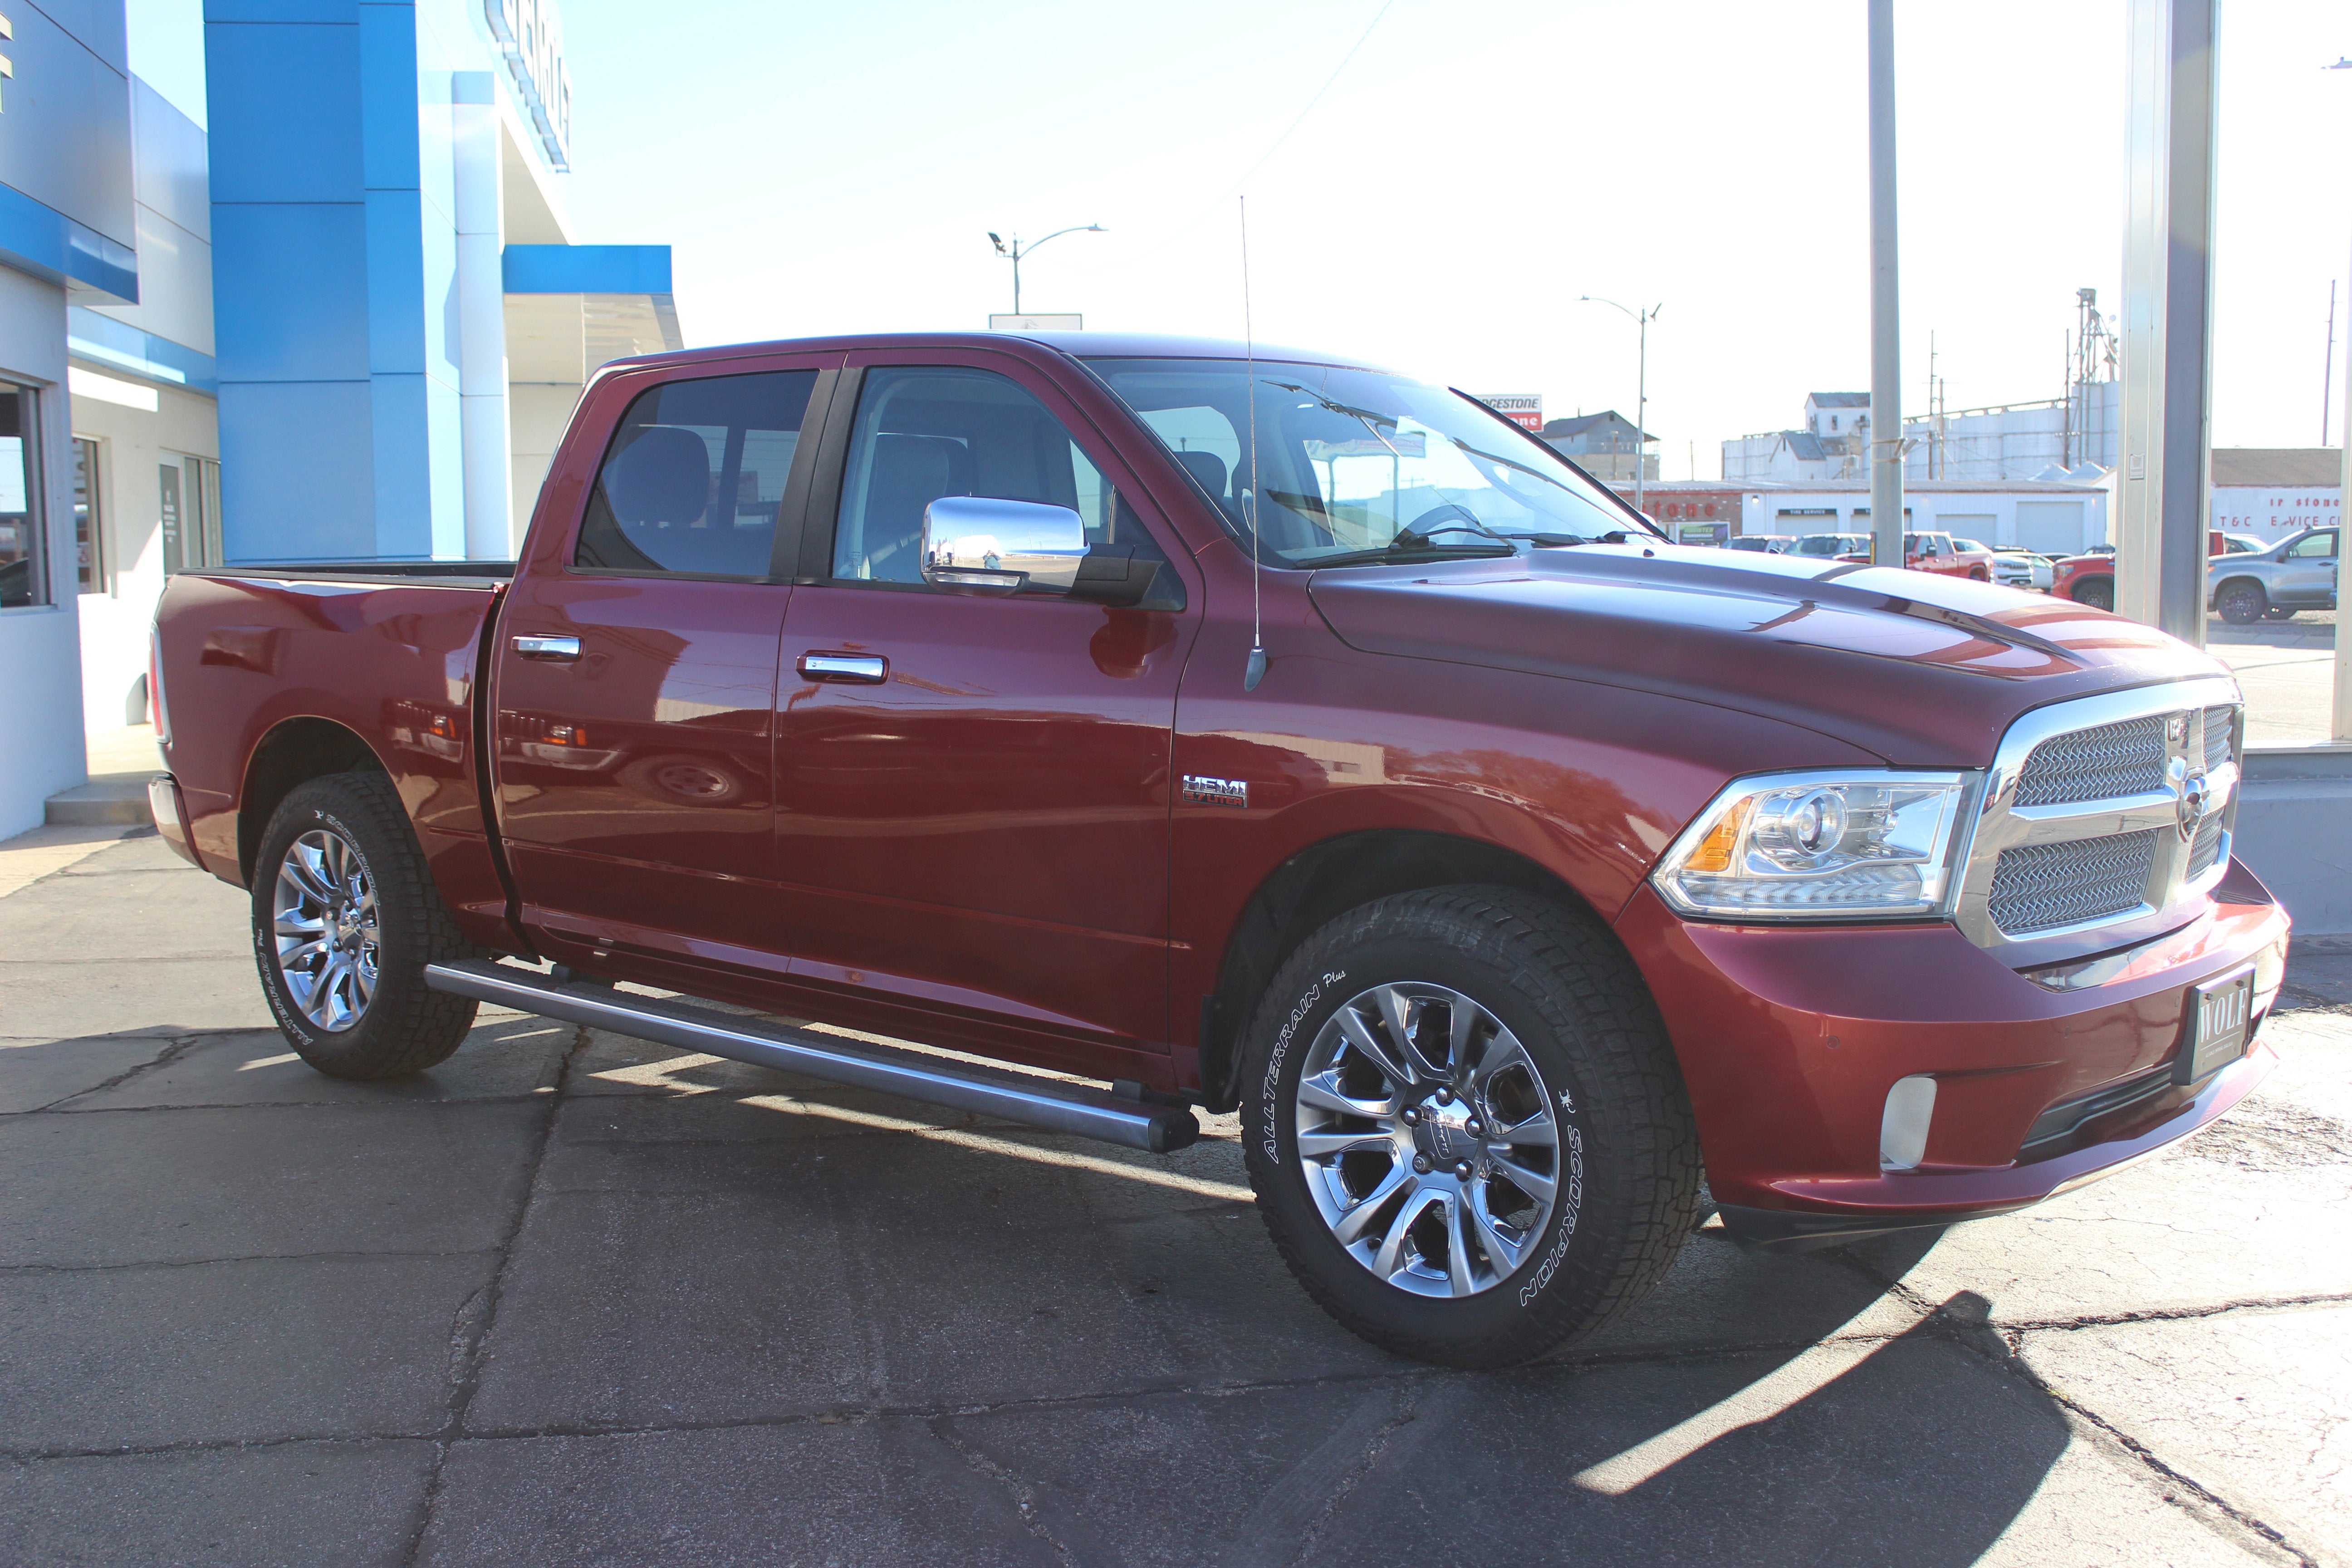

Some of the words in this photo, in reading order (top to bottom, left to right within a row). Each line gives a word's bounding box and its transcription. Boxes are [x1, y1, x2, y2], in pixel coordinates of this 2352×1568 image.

[1480, 398, 1539, 408] DGESTONE
[1183, 774, 1248, 795] HEMI
[1185, 791, 1205, 801] 5.7
[1207, 794, 1243, 806] LITER
[1323, 970, 1347, 988] Plus
[2200, 987, 2248, 1043] WOLF
[1519, 1125, 1583, 1307] SCORPION
